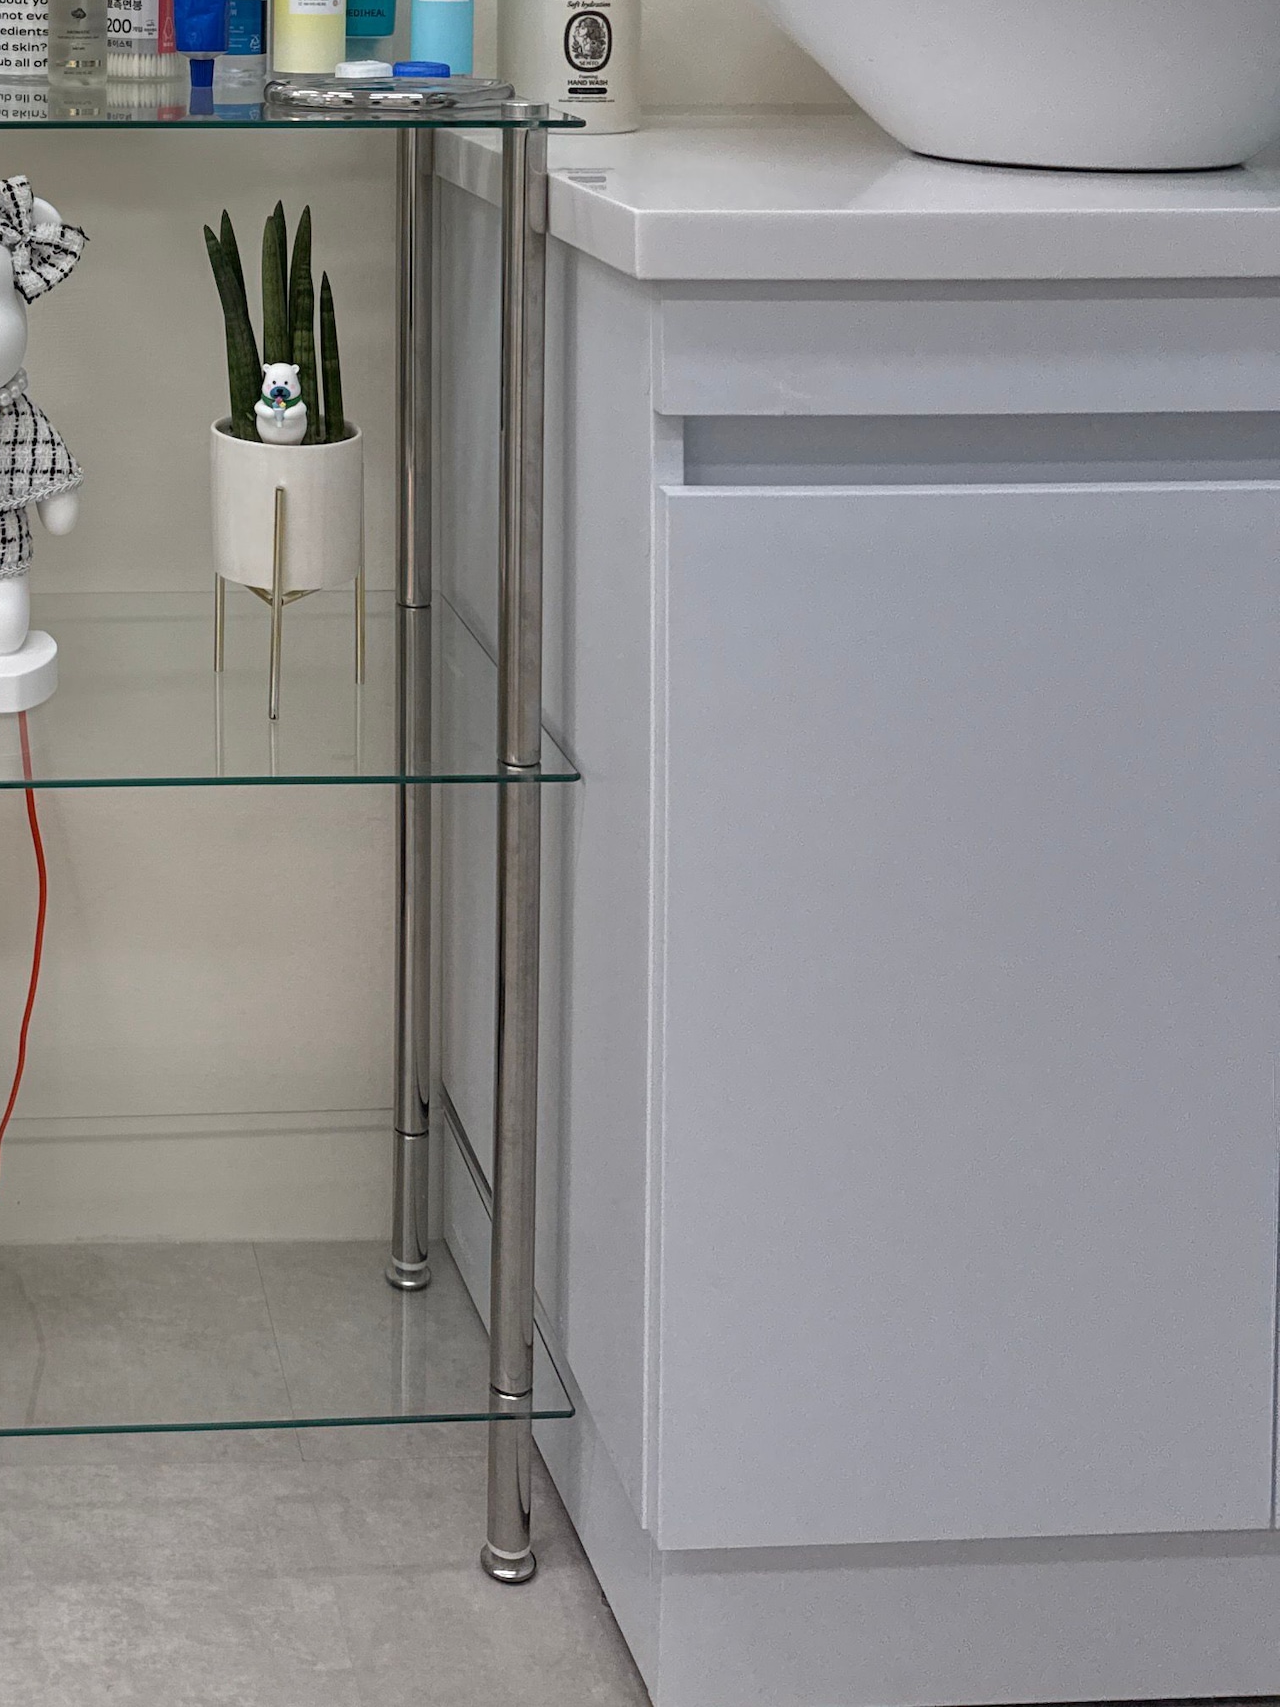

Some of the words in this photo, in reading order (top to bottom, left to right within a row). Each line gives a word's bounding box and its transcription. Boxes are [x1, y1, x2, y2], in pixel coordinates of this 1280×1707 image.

[566, 0, 580, 9] Soft
[581, 0, 611, 9] hydration
[347, 8, 386, 17] EDIHEAL
[107, 17, 132, 34] 200
[12, 42, 47, 52] skin?
[15, 57, 30, 68] all
